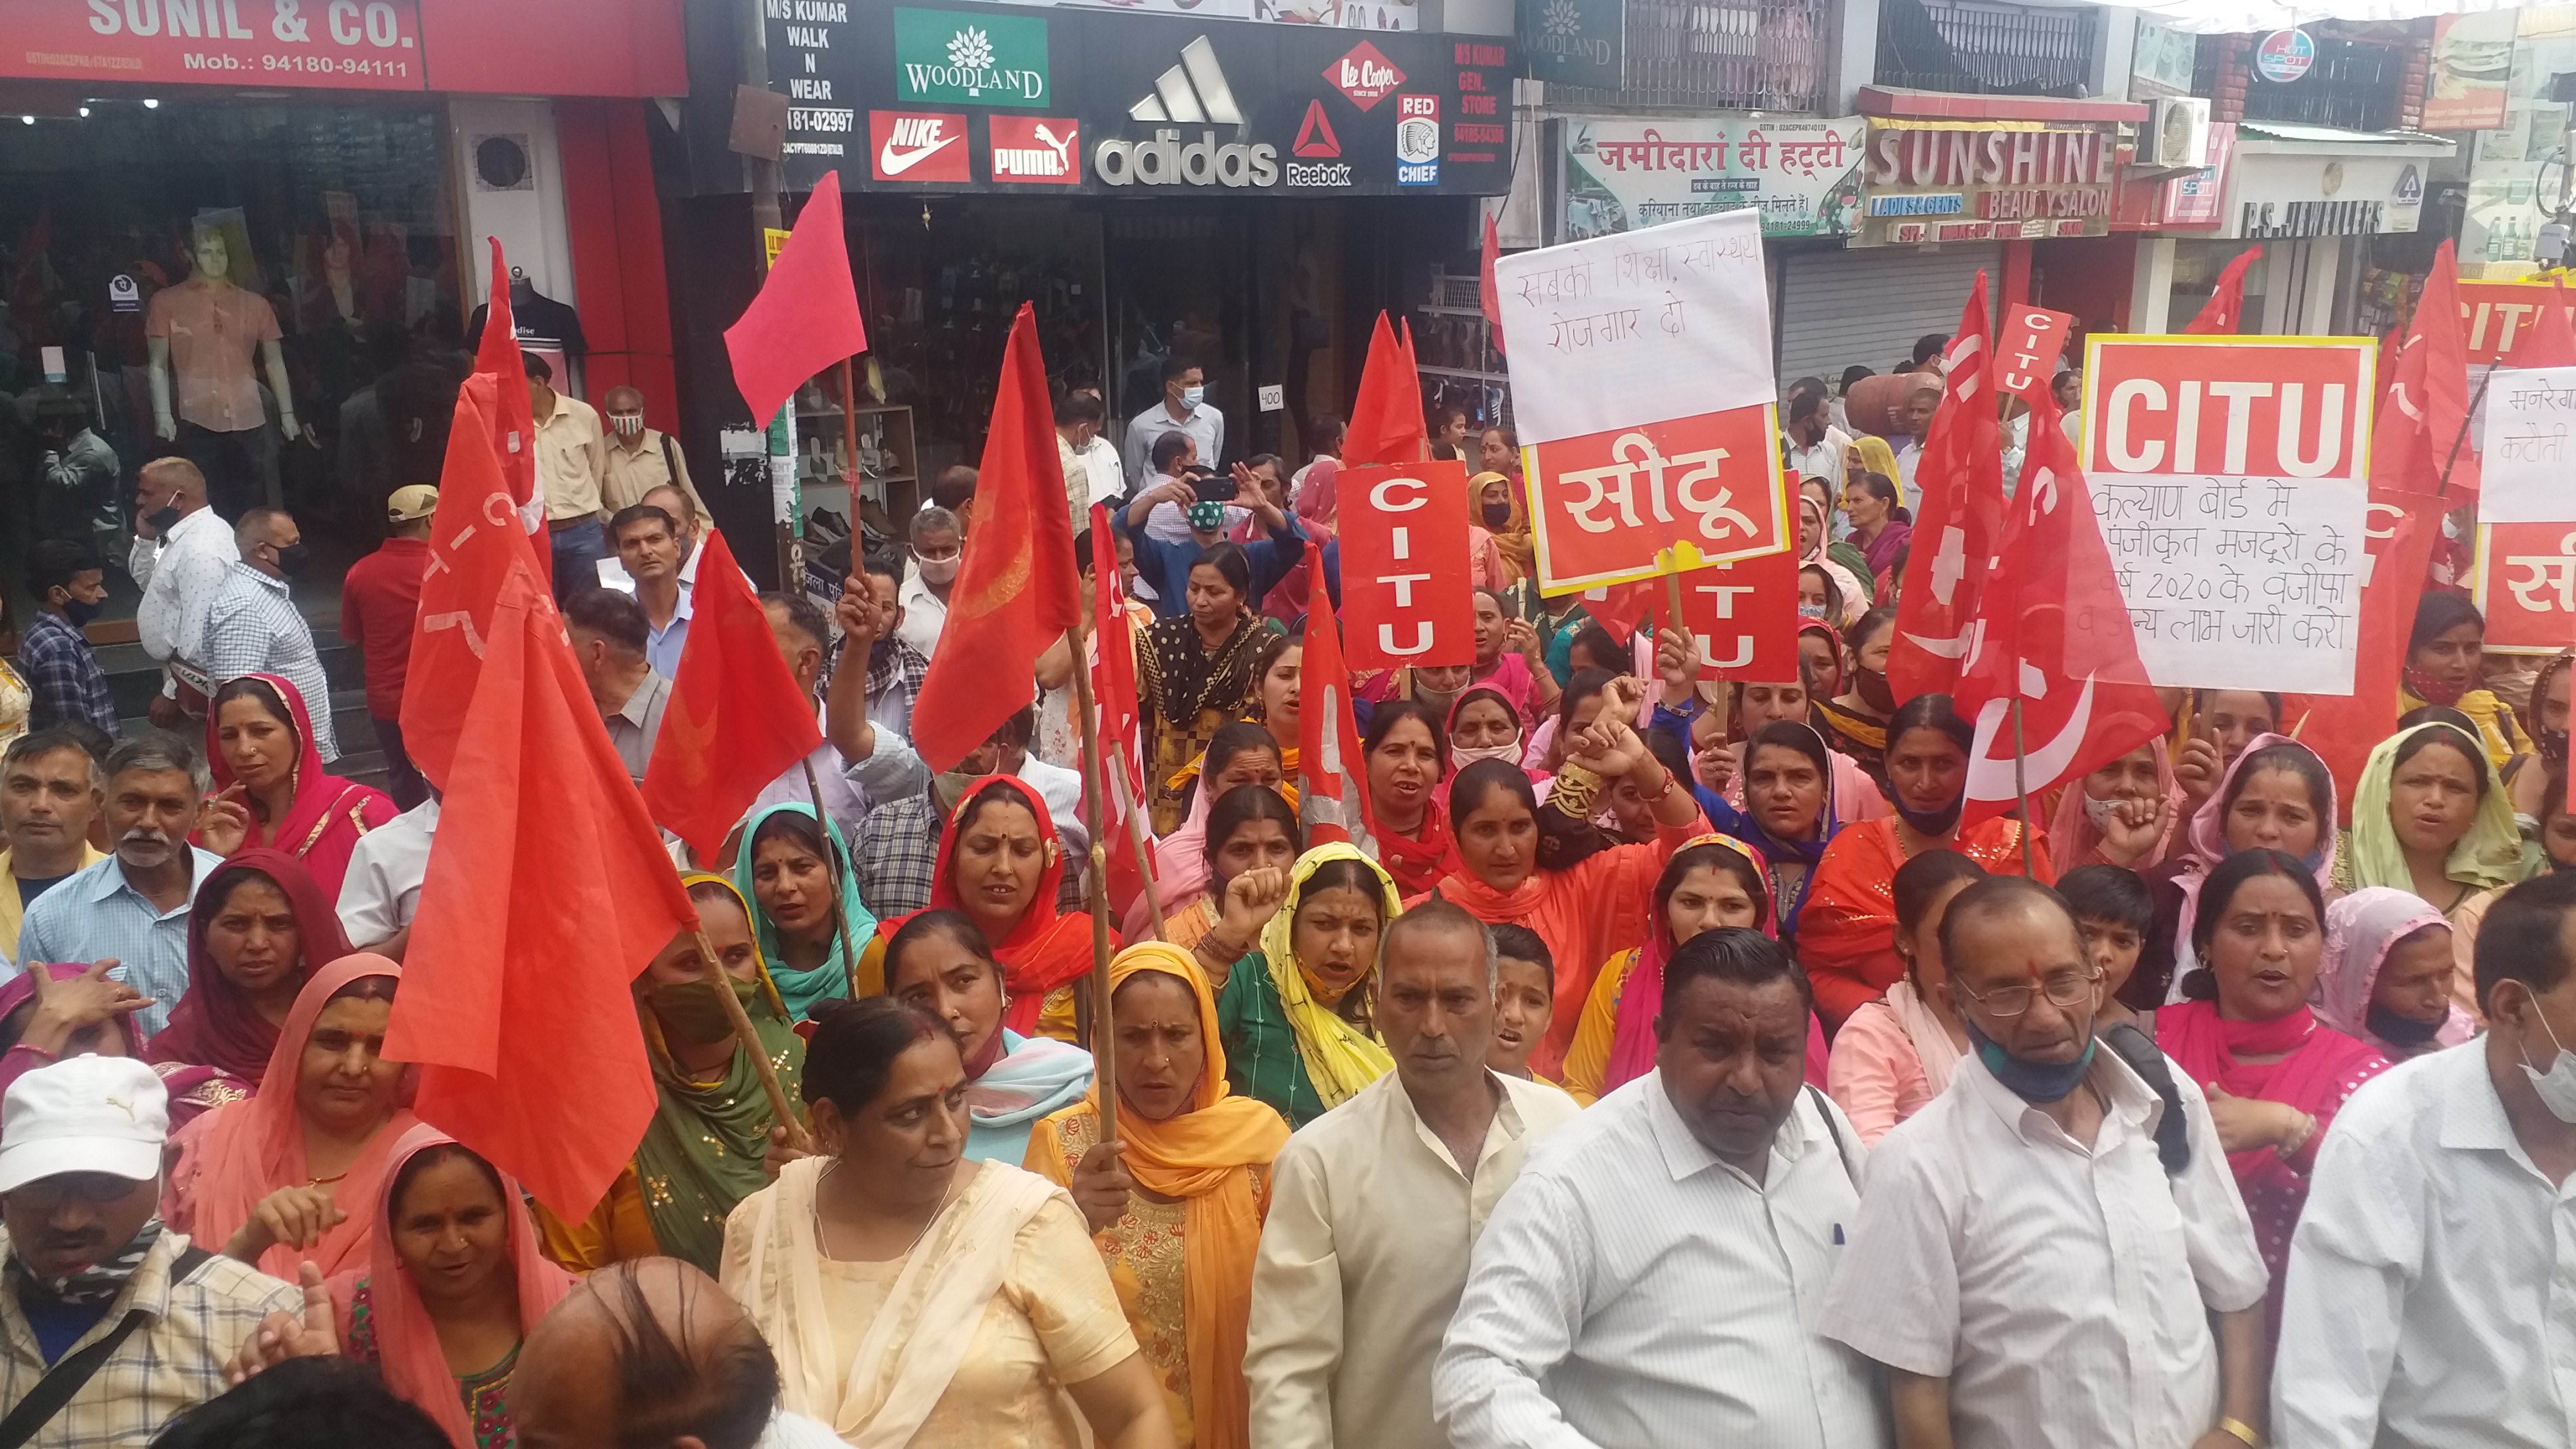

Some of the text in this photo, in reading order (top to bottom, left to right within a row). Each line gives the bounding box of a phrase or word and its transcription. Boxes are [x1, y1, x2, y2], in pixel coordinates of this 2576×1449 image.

[89, 0, 414, 49] SUNIL & CO.
[766, 0, 847, 23] M/S KUMAR
[787, 26, 829, 49] WALK
[262, 56, 407, 77] 94180-94111
[805, 53, 816, 73] N
[1472, 44, 1505, 67] KUMAR
[2264, 54, 2307, 65] SPOT
[790, 79, 832, 100] WEAR
[905, 63, 1043, 100] WOODLAND
[1341, 58, 1399, 93] Lee Cooper
[1403, 98, 1434, 115] RED
[1462, 94, 1497, 115] STORE
[787, 110, 853, 132] 181-02997
[892, 117, 944, 147] NIKE
[1759, 124, 1775, 132] GSTIN
[995, 149, 1058, 176] PUMA
[1095, 128, 1278, 188] adidas
[1738, 129, 1772, 172] दी
[1876, 128, 2115, 186] SUNSHINE
[1287, 163, 1351, 187] Reebok
[1399, 165, 1437, 183] CHIEF
[2182, 182, 2212, 194] SPOT
[1638, 198, 1679, 217] करियाना
[1682, 202, 1701, 216] तथा
[1772, 195, 1796, 212] मिलते
[1988, 189, 2109, 219] BEAUY SALON
[2283, 200, 2384, 237] JEWELLERS
[1660, 290, 1686, 338] दो
[2005, 314, 2053, 390] CITU
[1261, 391, 1280, 406] 400
[2105, 378, 2346, 478] CITU
[1559, 432, 1759, 541] सीटू
[2091, 484, 2188, 521] कल्याण
[2199, 477, 2249, 520] बोर्ड
[2314, 525, 2347, 566] के
[1369, 477, 1436, 656] CITU
[2146, 572, 2212, 600] 2020
[2220, 564, 2250, 603] के
[2170, 609, 2226, 642] लाभ
[2232, 604, 2288, 645] जारी
[2293, 605, 2352, 650] करो
